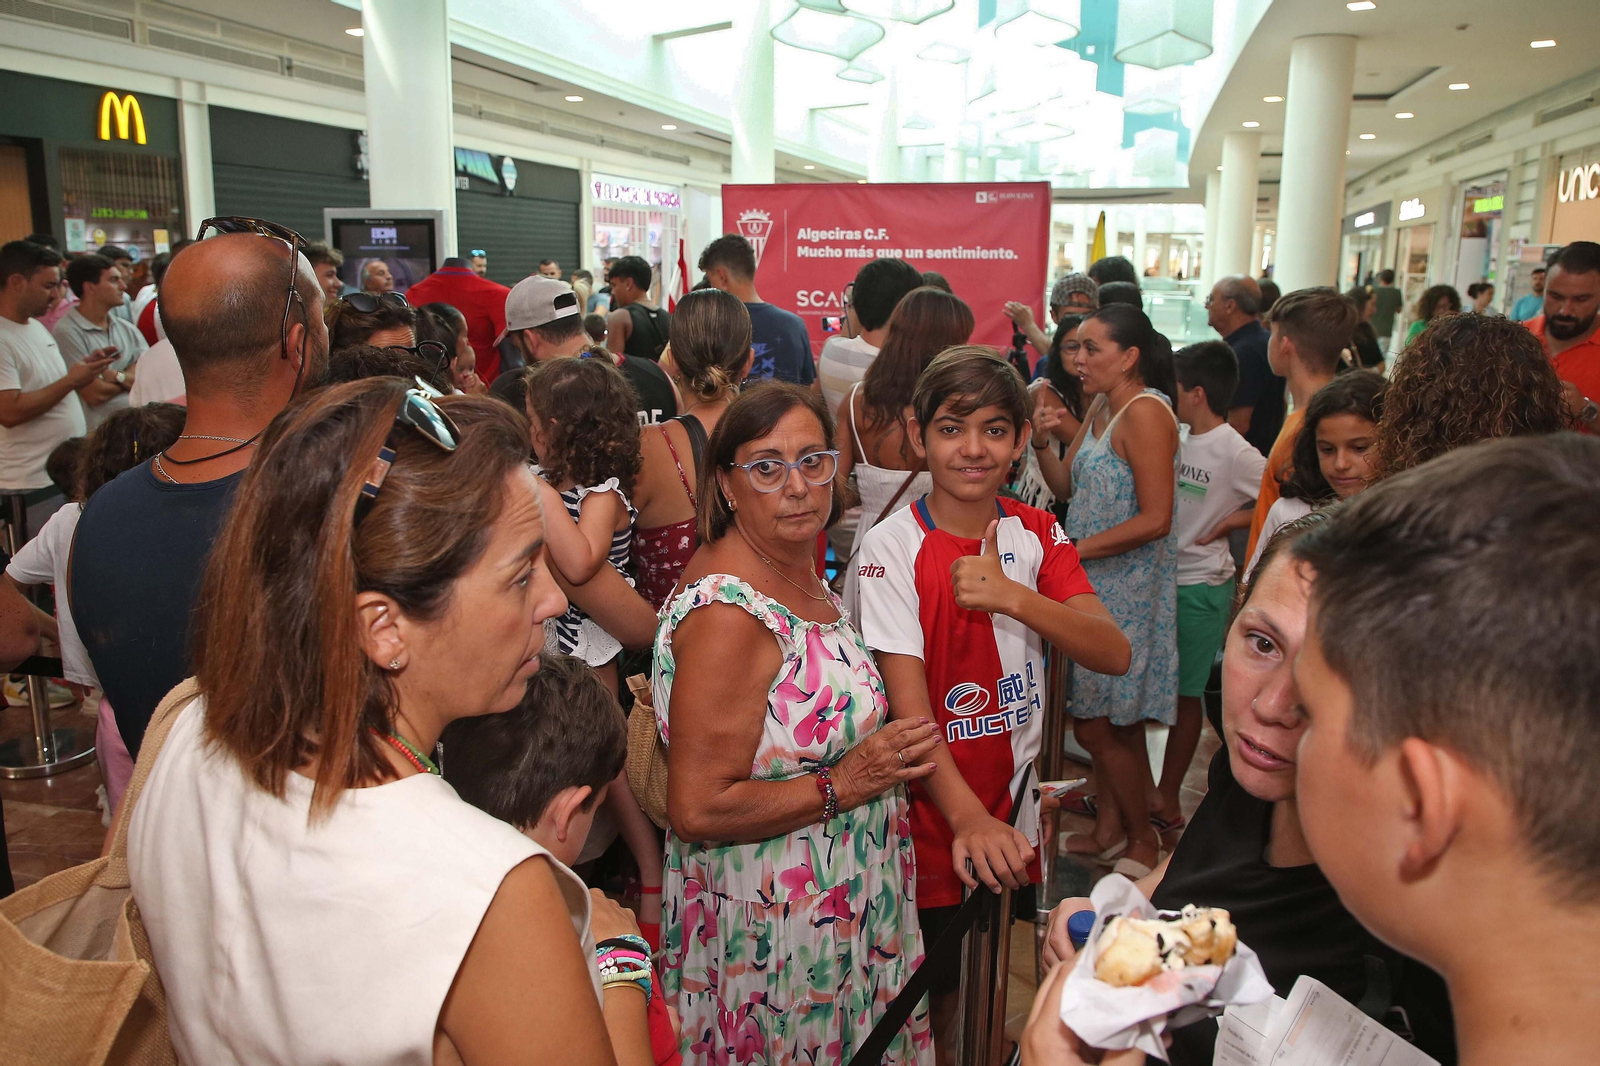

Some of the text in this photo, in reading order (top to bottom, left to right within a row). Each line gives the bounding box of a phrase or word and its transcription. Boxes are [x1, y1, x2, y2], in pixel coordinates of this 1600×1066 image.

[797, 227, 890, 243] Algeciras C.F.
[797, 245, 843, 258] Mucho
[845, 244, 874, 258] más
[904, 248, 924, 259] un
[925, 246, 1018, 260] sentimiento.
[858, 563, 885, 578] atra
